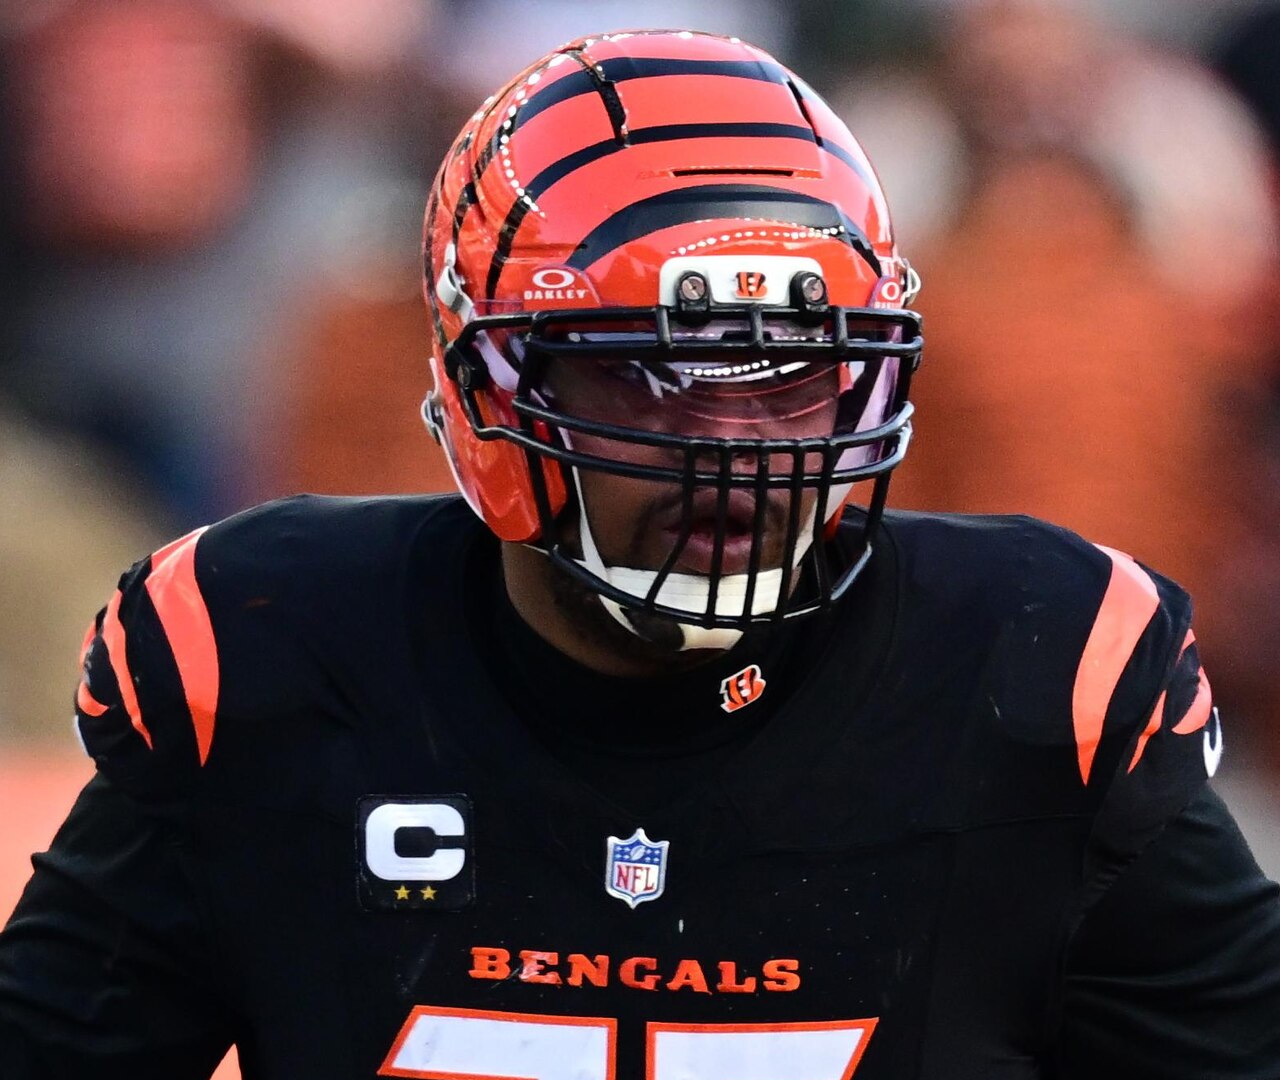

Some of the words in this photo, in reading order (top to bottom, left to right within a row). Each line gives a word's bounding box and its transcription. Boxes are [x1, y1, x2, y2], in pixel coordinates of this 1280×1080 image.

[523, 289, 586, 300] OAKLEY
[365, 803, 466, 882] C
[616, 864, 655, 894] NFL
[469, 946, 802, 995] BENGALS
